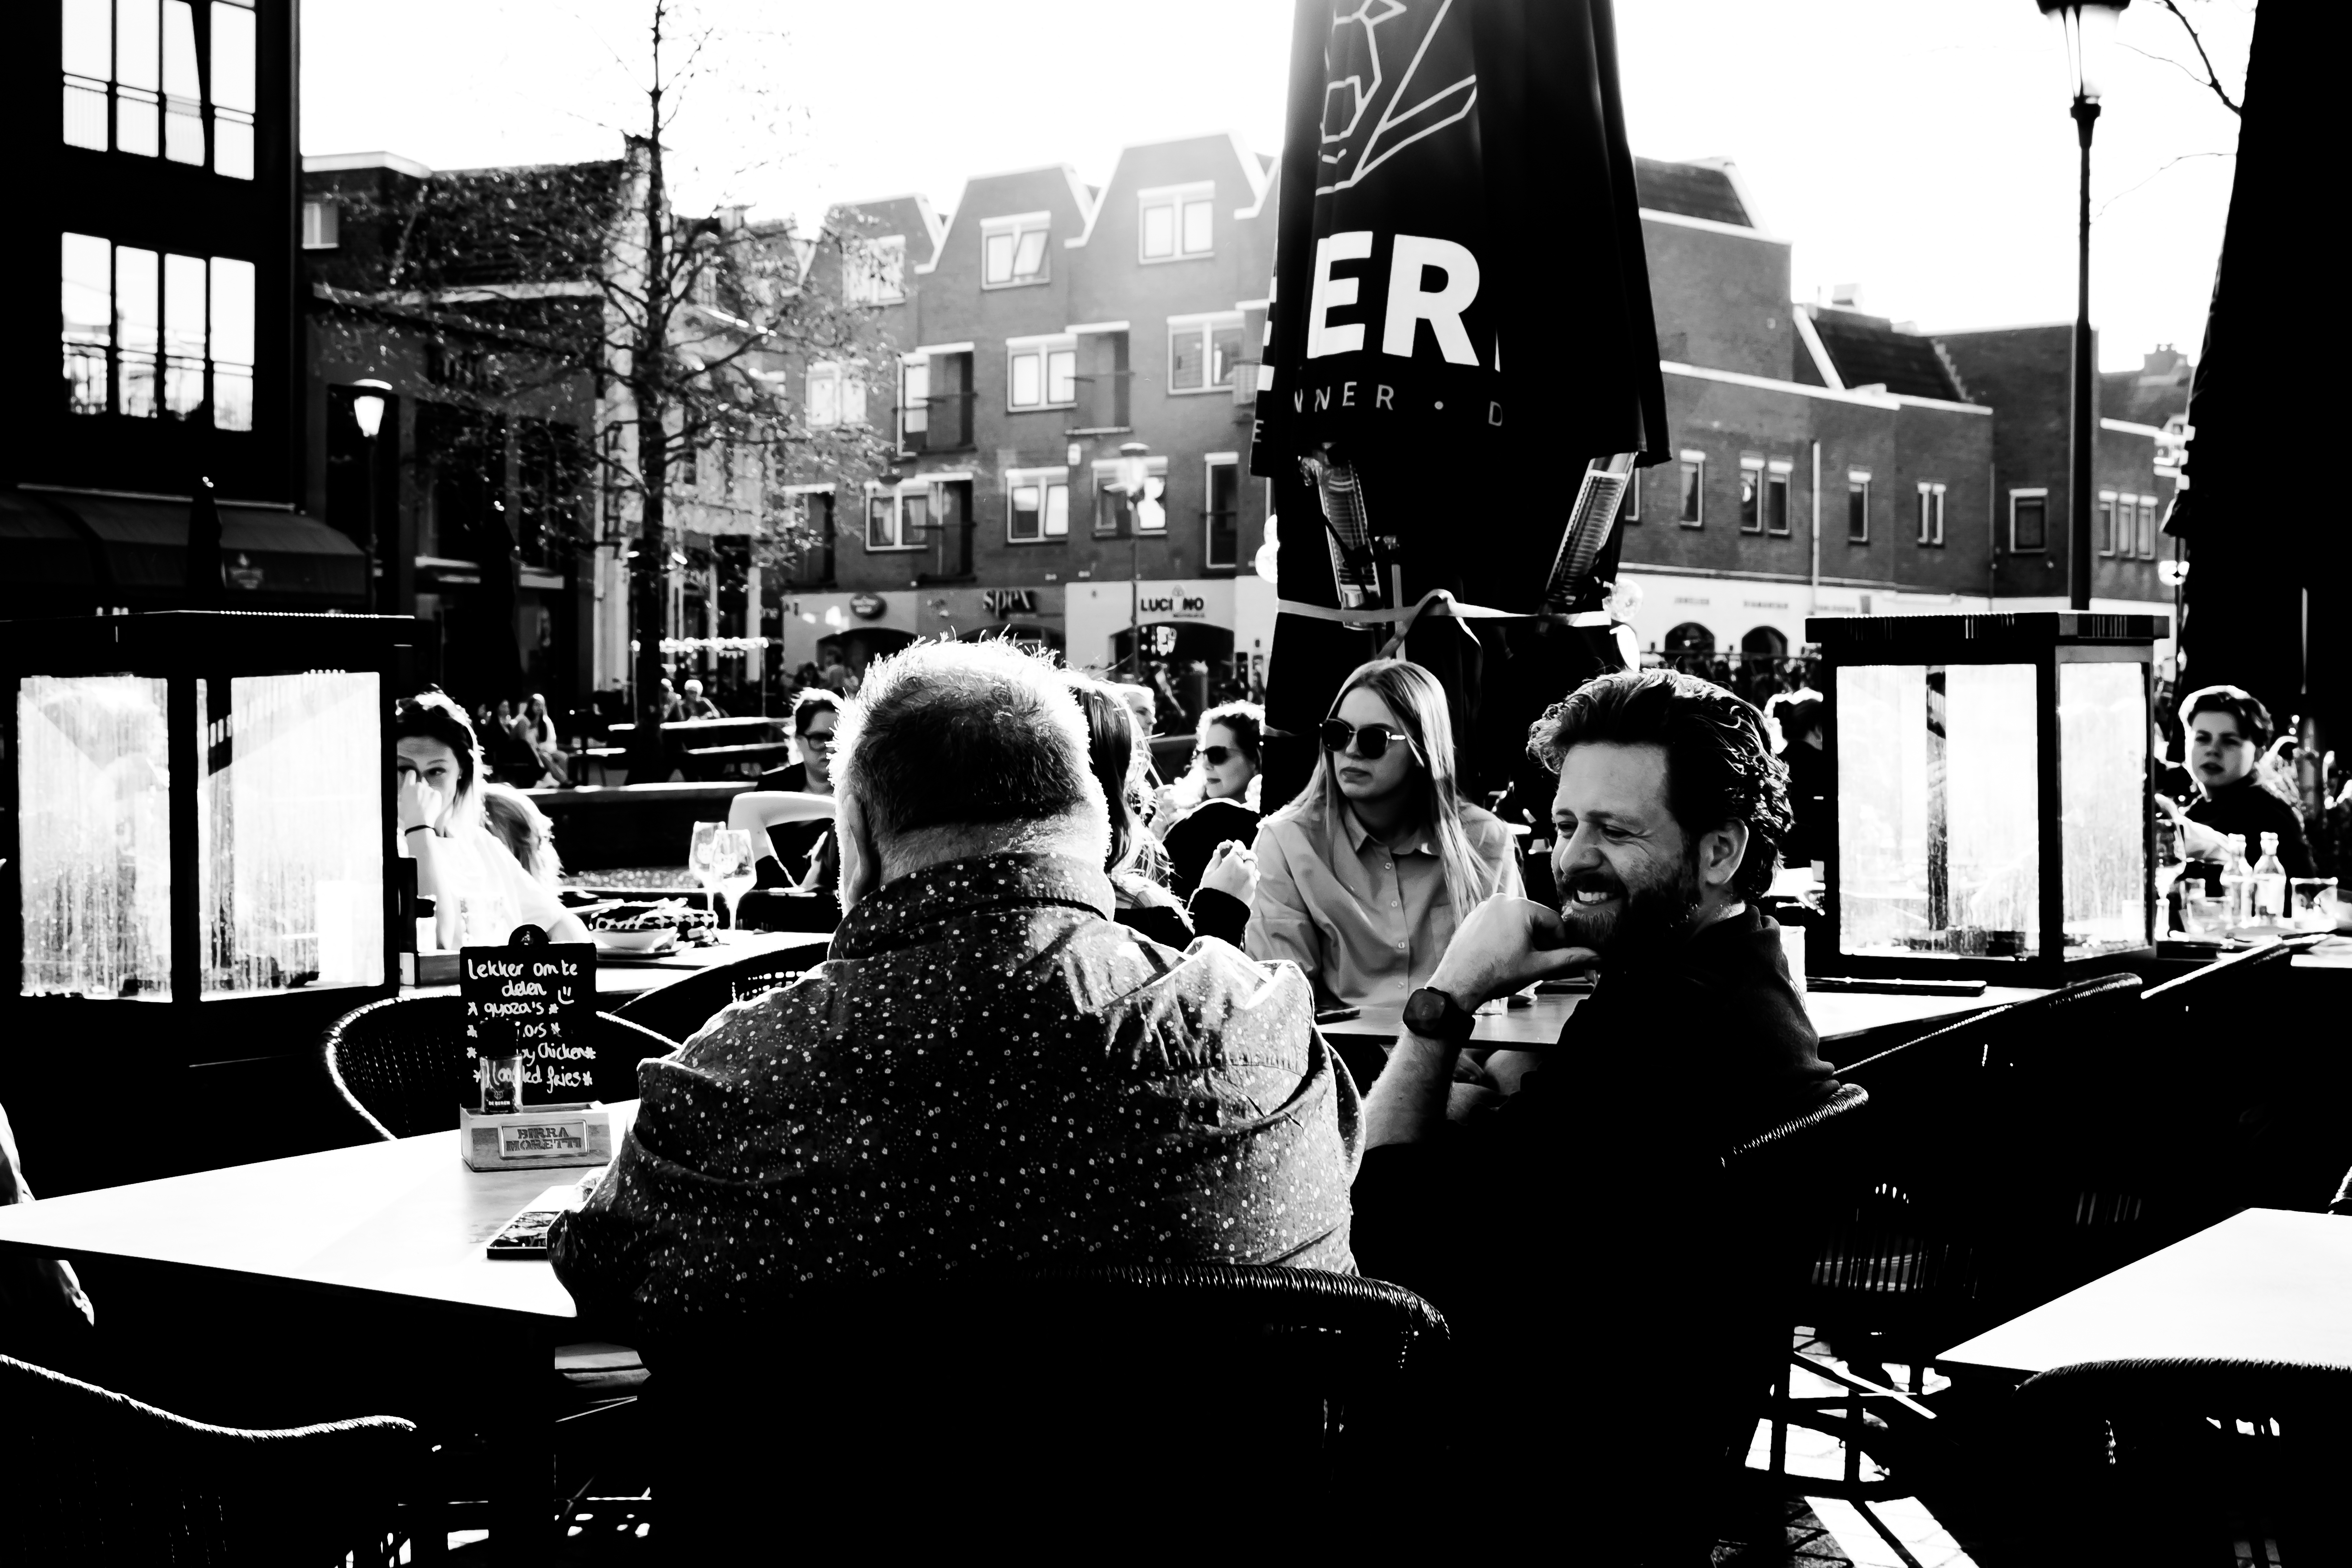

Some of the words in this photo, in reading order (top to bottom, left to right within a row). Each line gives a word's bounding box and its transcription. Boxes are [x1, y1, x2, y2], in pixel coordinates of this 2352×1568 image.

[1307, 231, 1500, 372] ER
[502, 980, 547, 997] delen
[547, 1066, 581, 1094] fries
[517, 1127, 569, 1139] BIRRA
[506, 1137, 581, 1151] MORETTI
